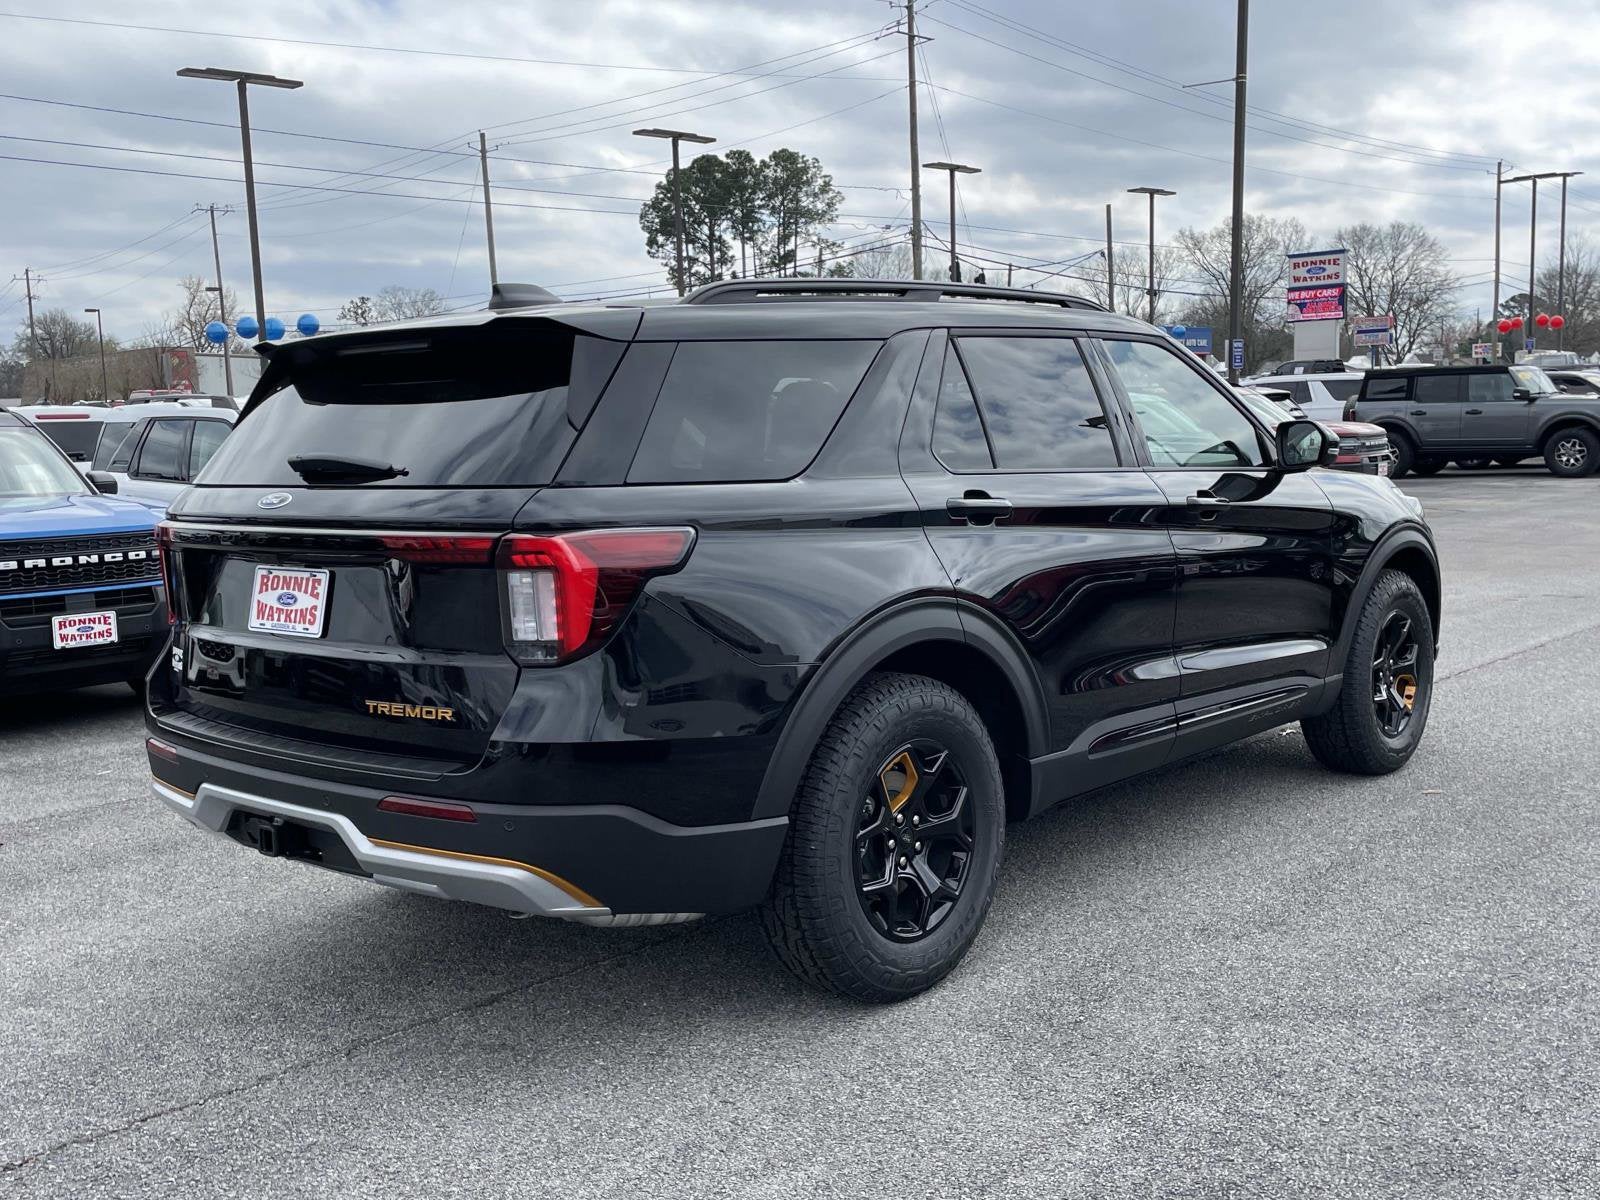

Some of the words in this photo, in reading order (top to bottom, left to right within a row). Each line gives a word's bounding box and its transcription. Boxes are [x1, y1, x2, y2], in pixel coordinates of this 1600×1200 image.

[1293, 258, 1340, 270] RONNIE
[1293, 272, 1340, 283] WATKINS
[0, 550, 146, 570] BRONCO
[258, 574, 322, 600] RONNIE
[257, 599, 318, 626] WATKINS
[58, 614, 112, 631] RONNIE
[59, 628, 113, 643] WATKINS
[365, 700, 456, 721] TREMOR
